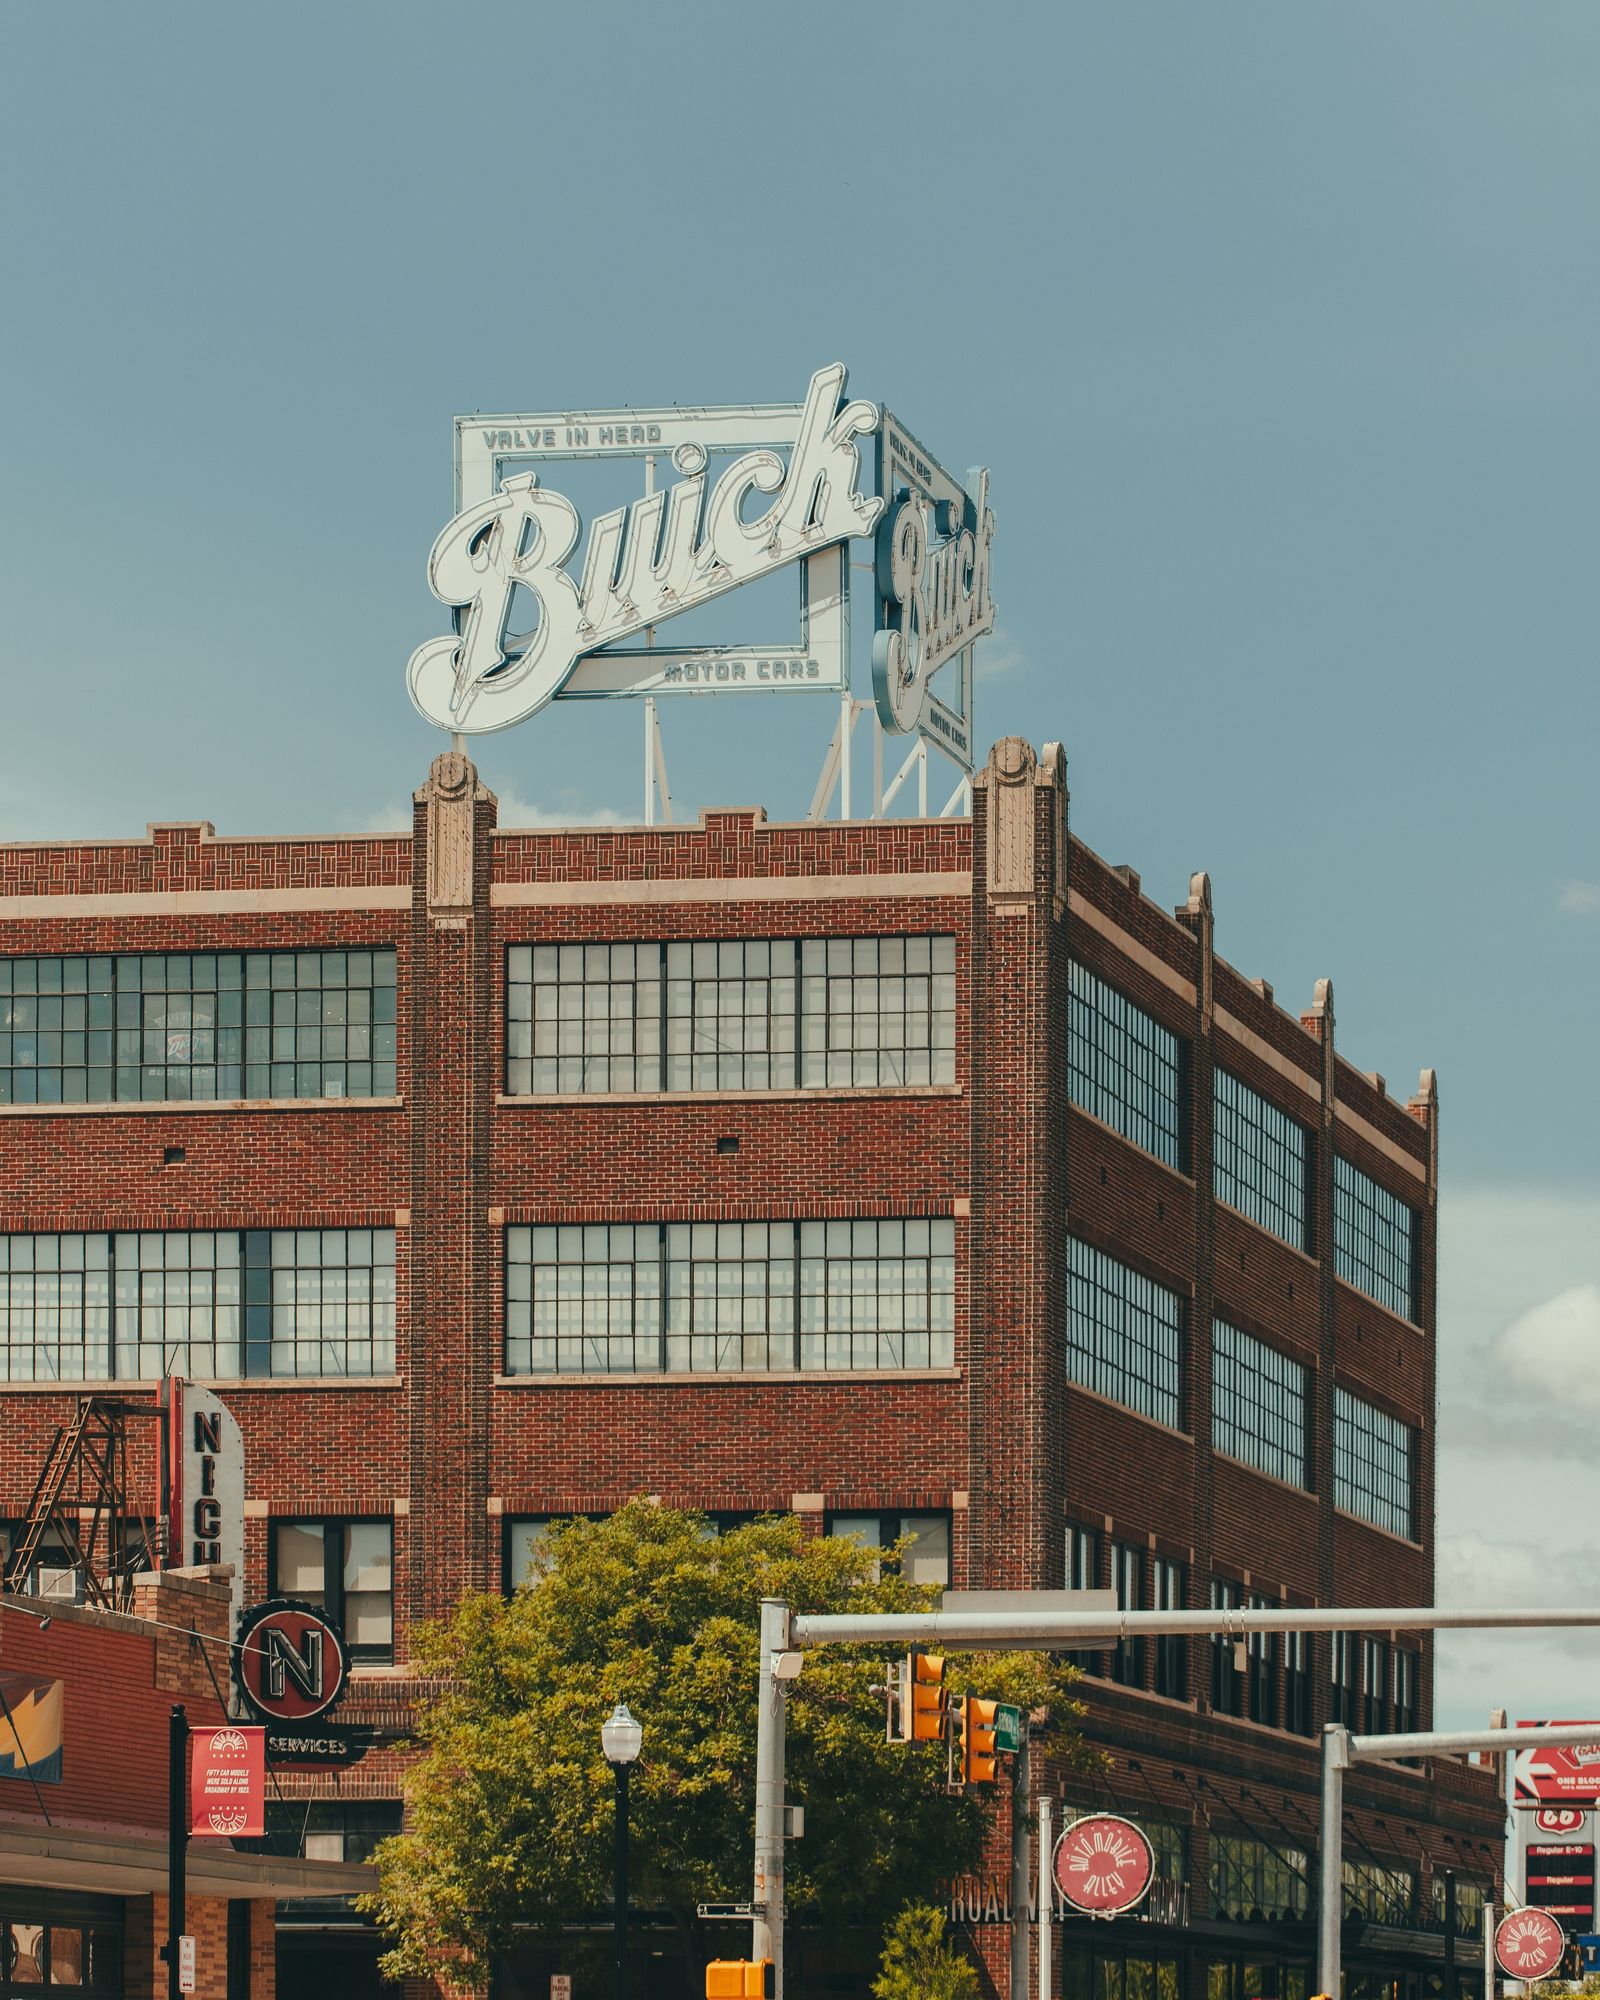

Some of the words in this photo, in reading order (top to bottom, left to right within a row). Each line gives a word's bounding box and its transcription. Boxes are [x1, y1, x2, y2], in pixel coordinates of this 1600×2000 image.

[483, 429, 556, 449] VALVE
[566, 428, 589, 446] IN
[600, 425, 661, 445] HEAD
[406, 361, 884, 735] Buick
[872, 465, 998, 736] Buick
[664, 663, 746, 682] MOTOR
[756, 660, 820, 679] CARS
[262, 1628, 323, 1702] N
[268, 1736, 348, 1755] SERVICES
[1557, 1777, 1576, 1785] ONE
[1069, 1832, 1137, 1872] AUTOMOBILE
[1536, 1846, 1564, 1856] Regular
[1565, 1846, 1583, 1854] E-10
[1083, 1871, 1125, 1897] ALLEY
[1546, 1876, 1574, 1885] Regular
[1544, 1905, 1575, 1914] Premium
[1506, 1920, 1552, 1953] AUTOMOBILE
[1518, 1947, 1547, 1968] ALLEY
